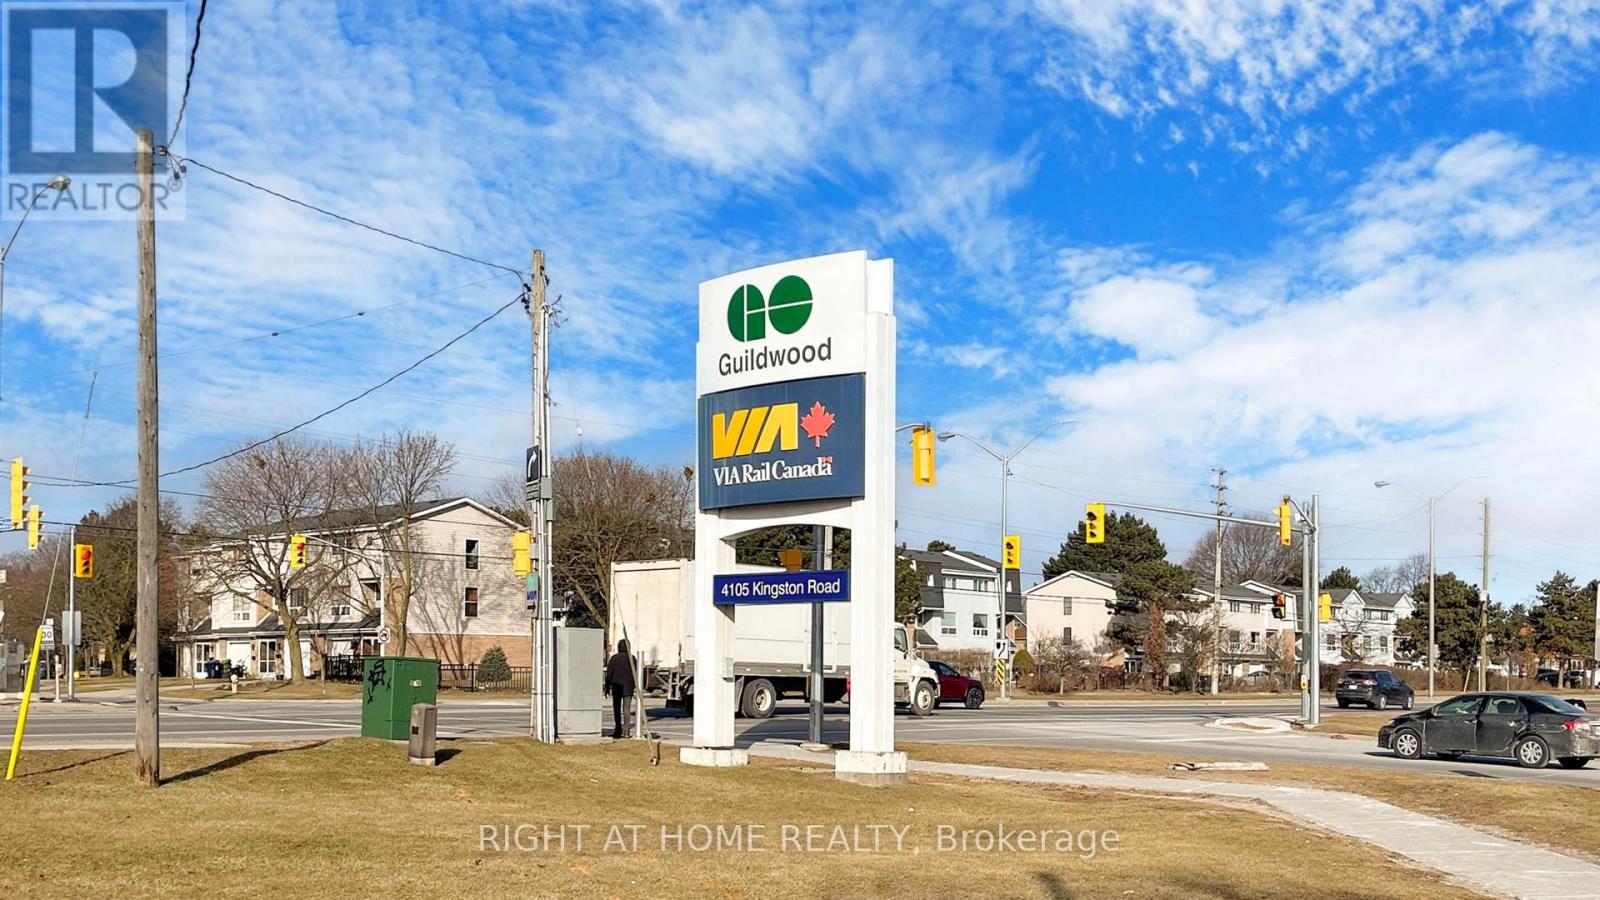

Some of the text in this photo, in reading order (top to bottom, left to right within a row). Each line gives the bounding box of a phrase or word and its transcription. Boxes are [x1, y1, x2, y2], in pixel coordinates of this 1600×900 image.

[727, 275, 813, 342] GO
[719, 337, 831, 376] Guildwood
[712, 403, 798, 460] VIA
[713, 456, 833, 486] VIA Rail Canada
[721, 578, 840, 598] 4105 Kingston Road
